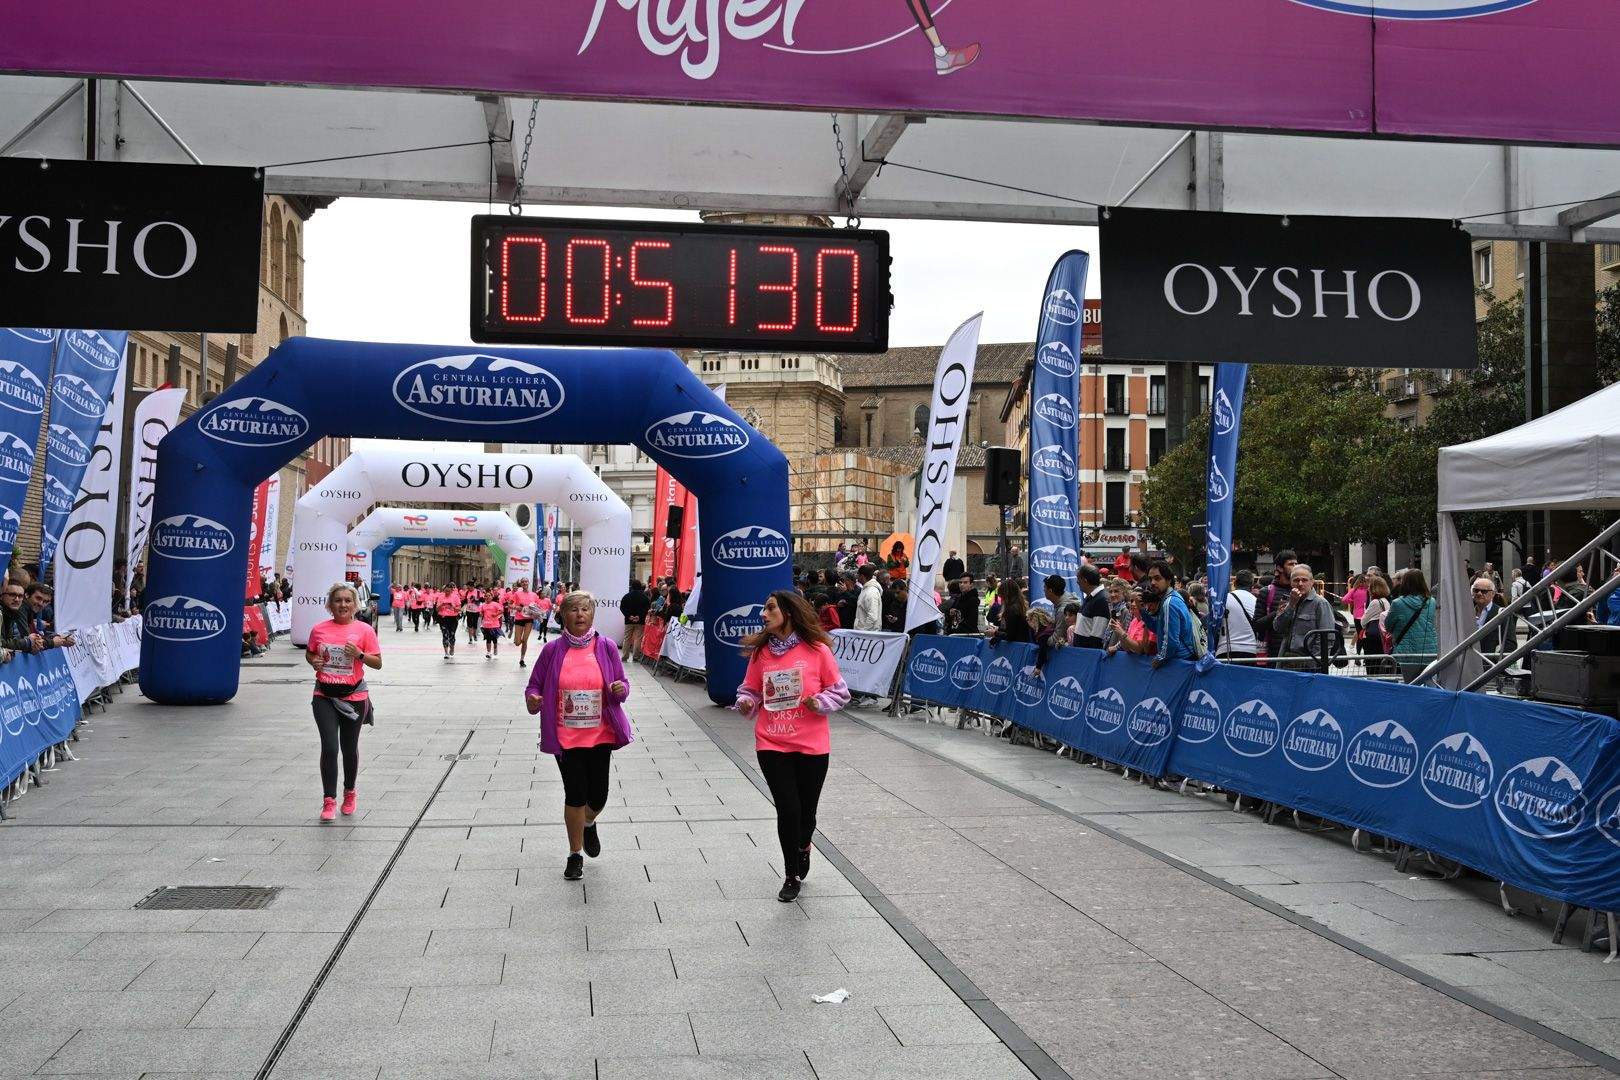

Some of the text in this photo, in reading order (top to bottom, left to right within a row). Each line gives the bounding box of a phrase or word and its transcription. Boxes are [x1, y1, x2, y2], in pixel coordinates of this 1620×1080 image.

[0, 216, 198, 279] SHO
[1163, 263, 1421, 321] OYSHO
[69, 331, 115, 367] ASTURIANA
[406, 374, 552, 408] ASTURIANA
[433, 373, 546, 385] CENTRAL LECHERA
[53, 380, 100, 414] ASTURIANA
[204, 413, 300, 436] ASTURIANA
[654, 429, 743, 447] ASTURIANA
[401, 462, 533, 489] OYSHO
[919, 362, 967, 573] OYSHO
[320, 489, 361, 500] OYSHO
[569, 493, 608, 502] OYSHO
[154, 529, 228, 550] ASTURIANA
[299, 542, 338, 552] OYSHO
[588, 546, 625, 556] OYSHO
[717, 543, 786, 559] ASTURIANA
[145, 610, 220, 631] ASTURIANA
[1226, 716, 1274, 746] ASTURIANA
[1285, 727, 1337, 759] ASTURIANA
[1350, 740, 1411, 775] ASTURIANA
[1424, 754, 1486, 795] ASTURIANA
[1500, 777, 1577, 824] ASTURIANA
